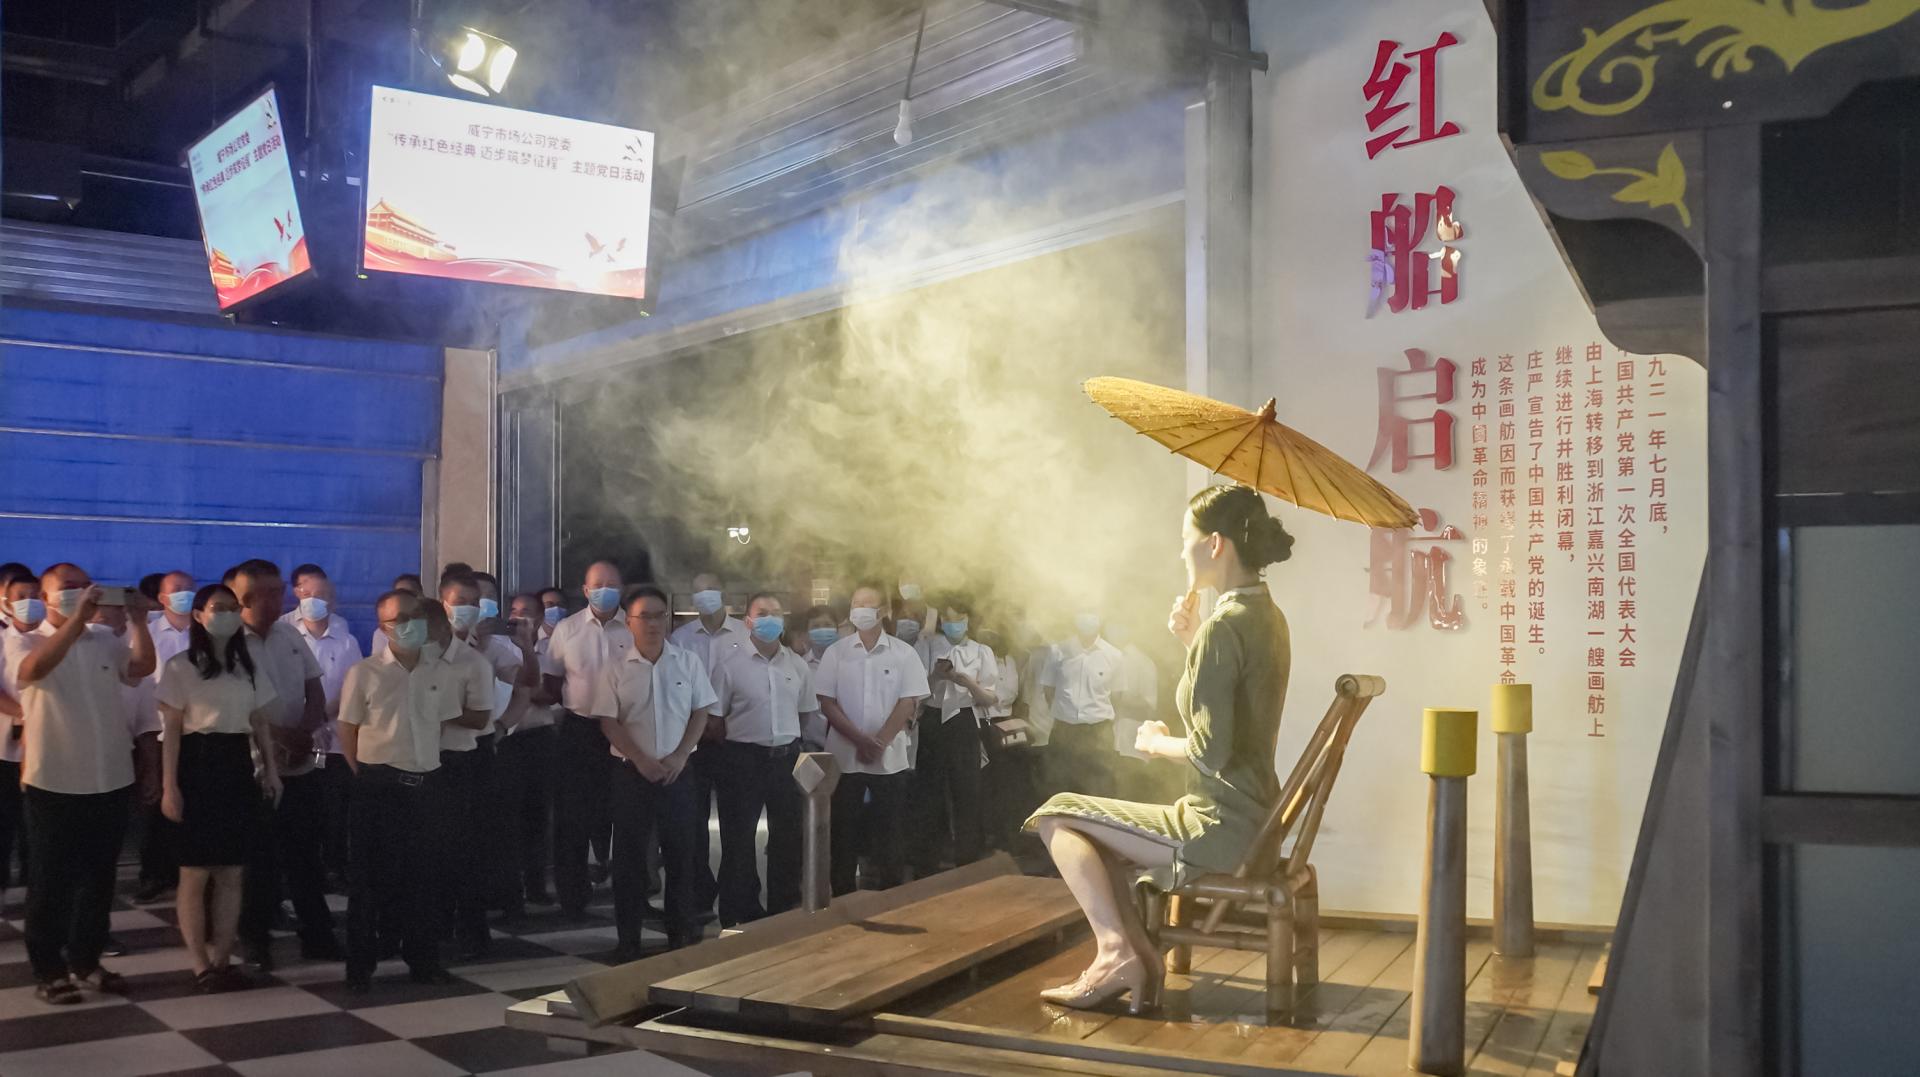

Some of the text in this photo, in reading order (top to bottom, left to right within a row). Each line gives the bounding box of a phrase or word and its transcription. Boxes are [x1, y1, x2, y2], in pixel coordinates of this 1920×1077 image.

[572, 160, 645, 183] 主题党日活动
[1362, 31, 1468, 632] 红船启航
[1527, 350, 1545, 654] 庄严宣告了中国共产党的诞生。
[1584, 341, 1605, 738] 由上海转移到浙江嘉兴南湖一艘画舫上
